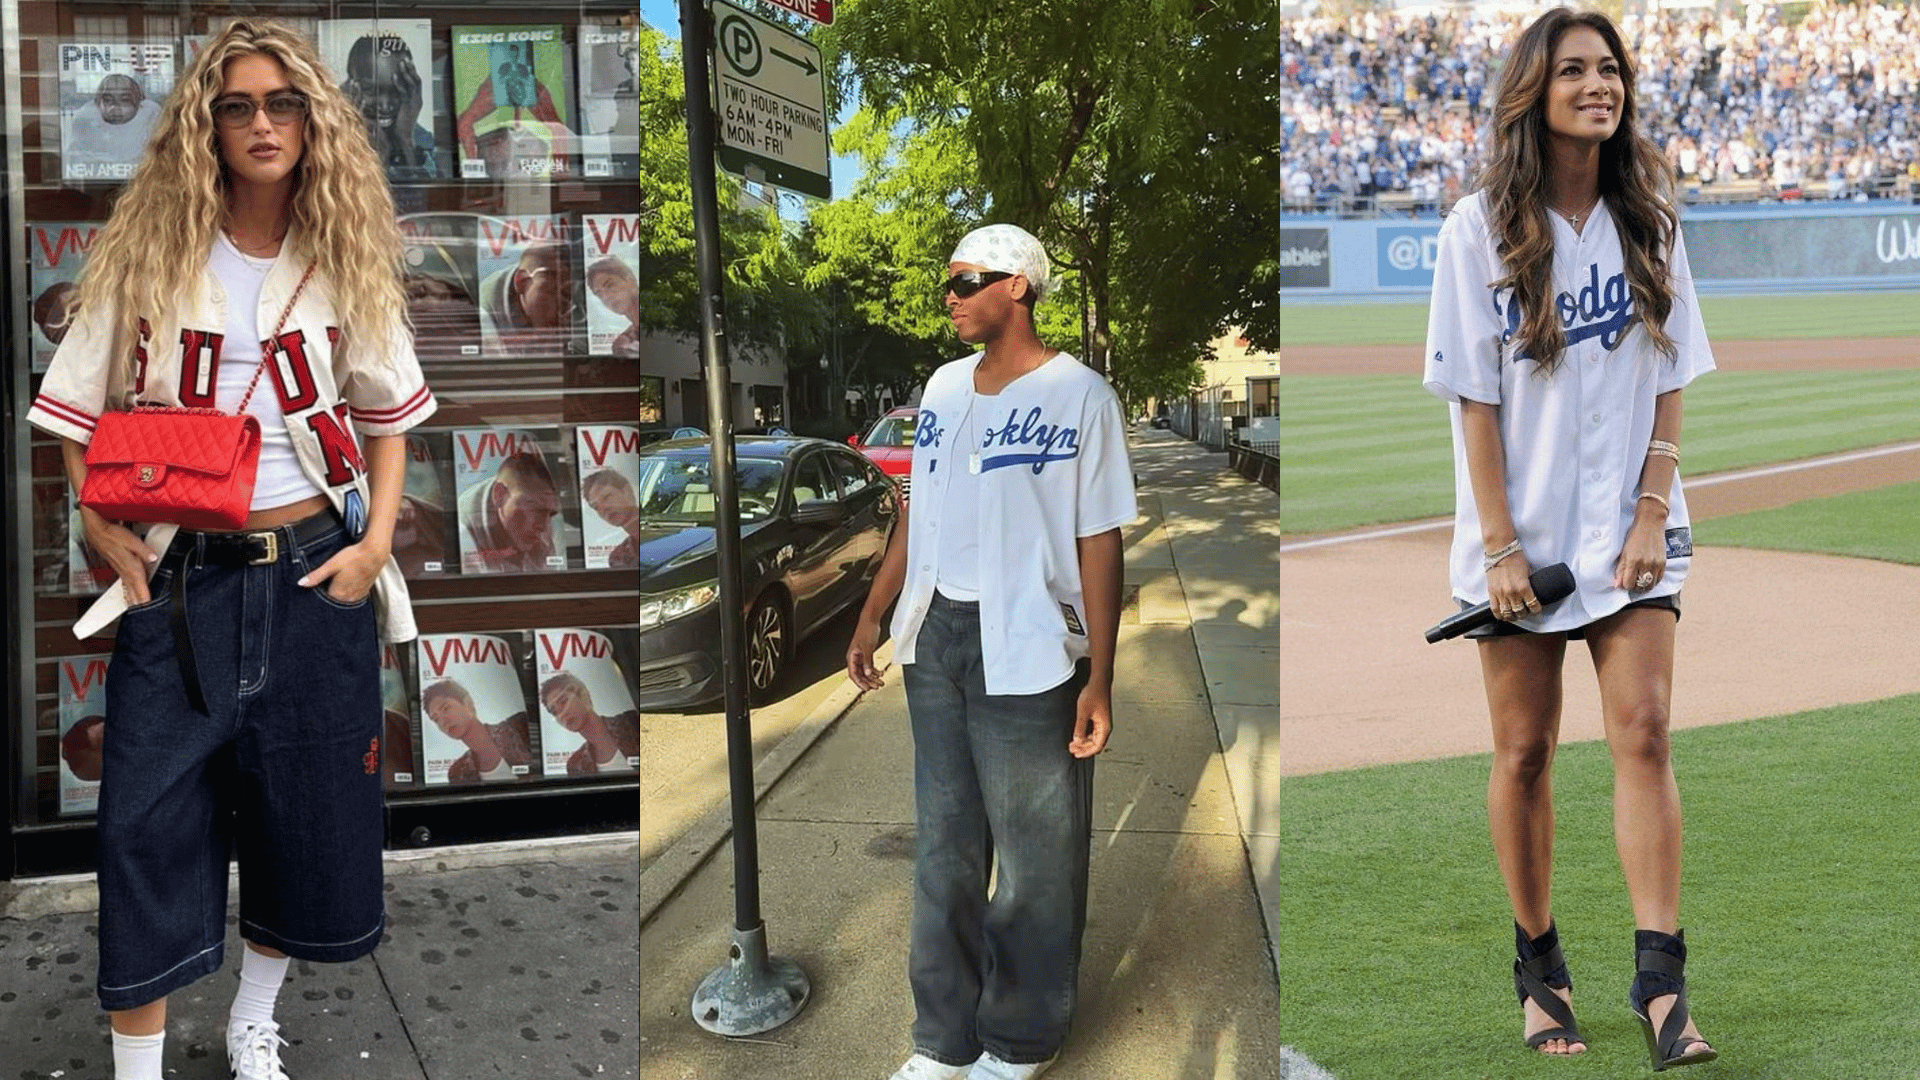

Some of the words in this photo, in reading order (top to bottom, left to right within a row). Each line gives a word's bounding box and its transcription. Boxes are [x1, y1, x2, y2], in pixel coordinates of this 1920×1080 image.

[779, 0, 819, 19] NE
[459, 32, 505, 44] KING
[507, 30, 554, 42] KONG
[733, 27, 753, 64] P
[723, 82, 747, 104] TWO
[751, 95, 779, 116] HOUR
[783, 105, 822, 133] PARKING
[65, 163, 94, 179] NEW
[97, 163, 138, 178] AMER
[36, 227, 97, 267] VM
[587, 217, 639, 255] VM
[457, 432, 537, 470] VMA
[581, 429, 639, 466] VM
[539, 633, 612, 671] VMA
